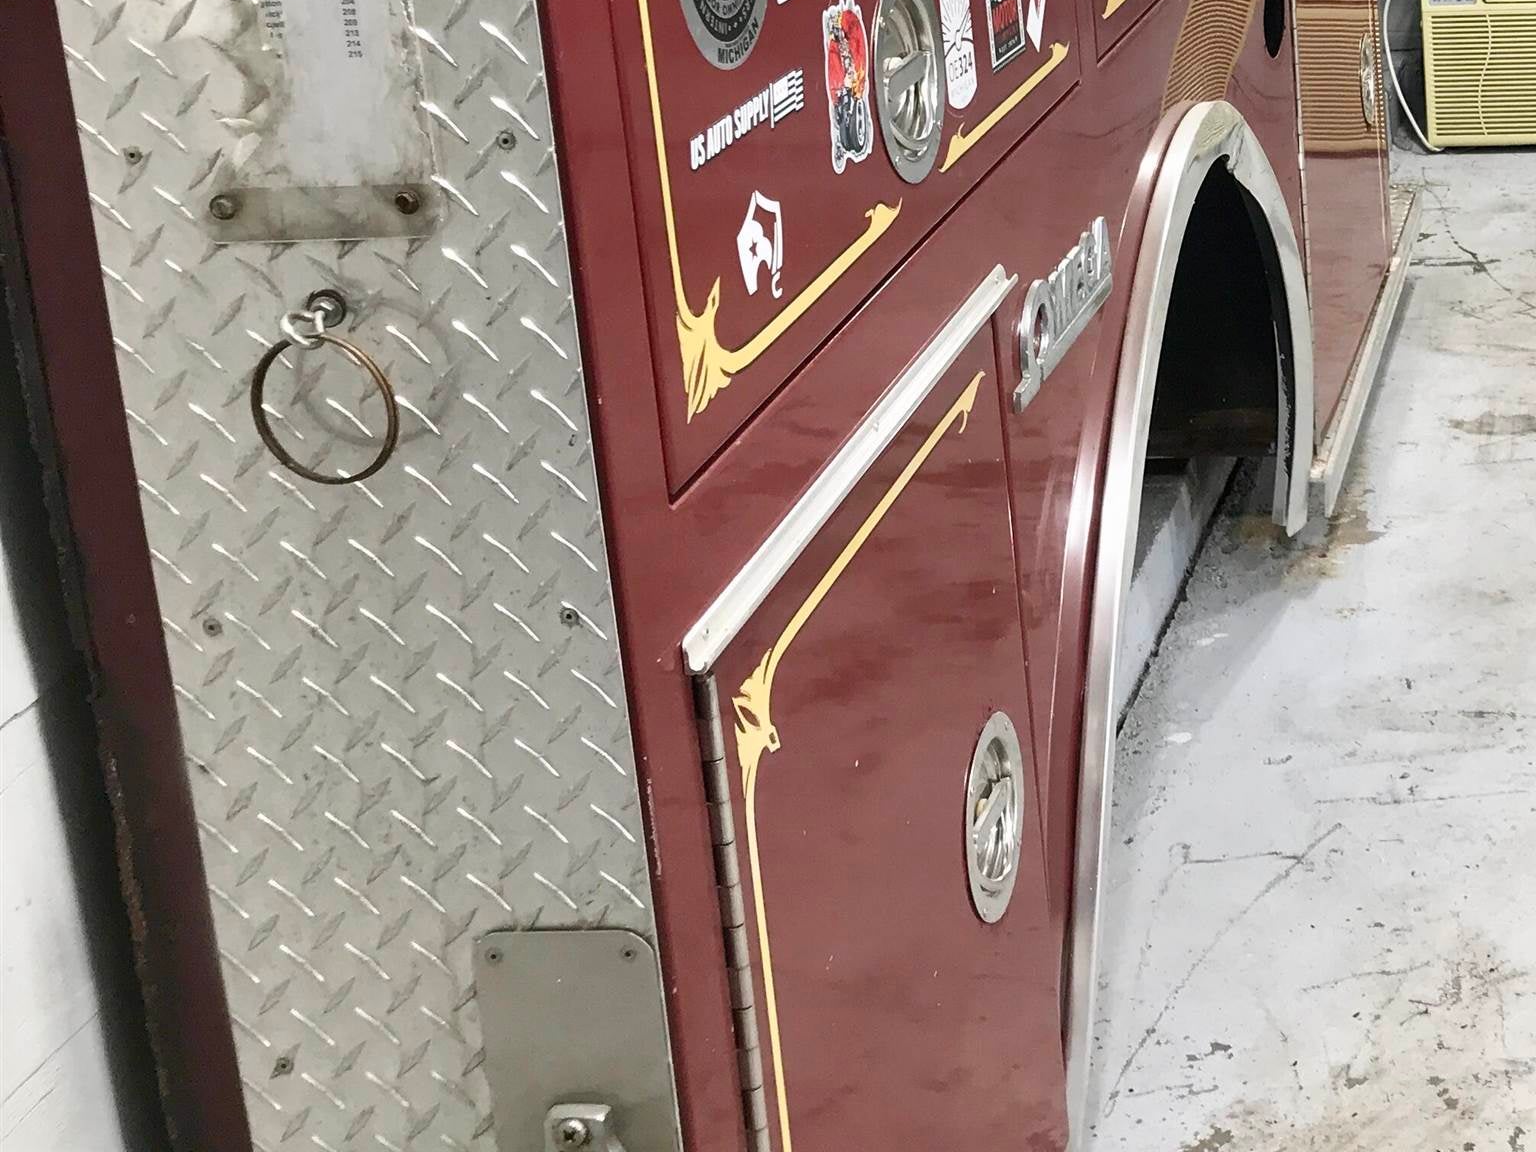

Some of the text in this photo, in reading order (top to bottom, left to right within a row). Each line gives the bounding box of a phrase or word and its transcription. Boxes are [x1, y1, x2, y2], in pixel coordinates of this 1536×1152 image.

[717, 17, 759, 64] MICHIGAN
[690, 88, 770, 170] US AUTO SUPPLY
